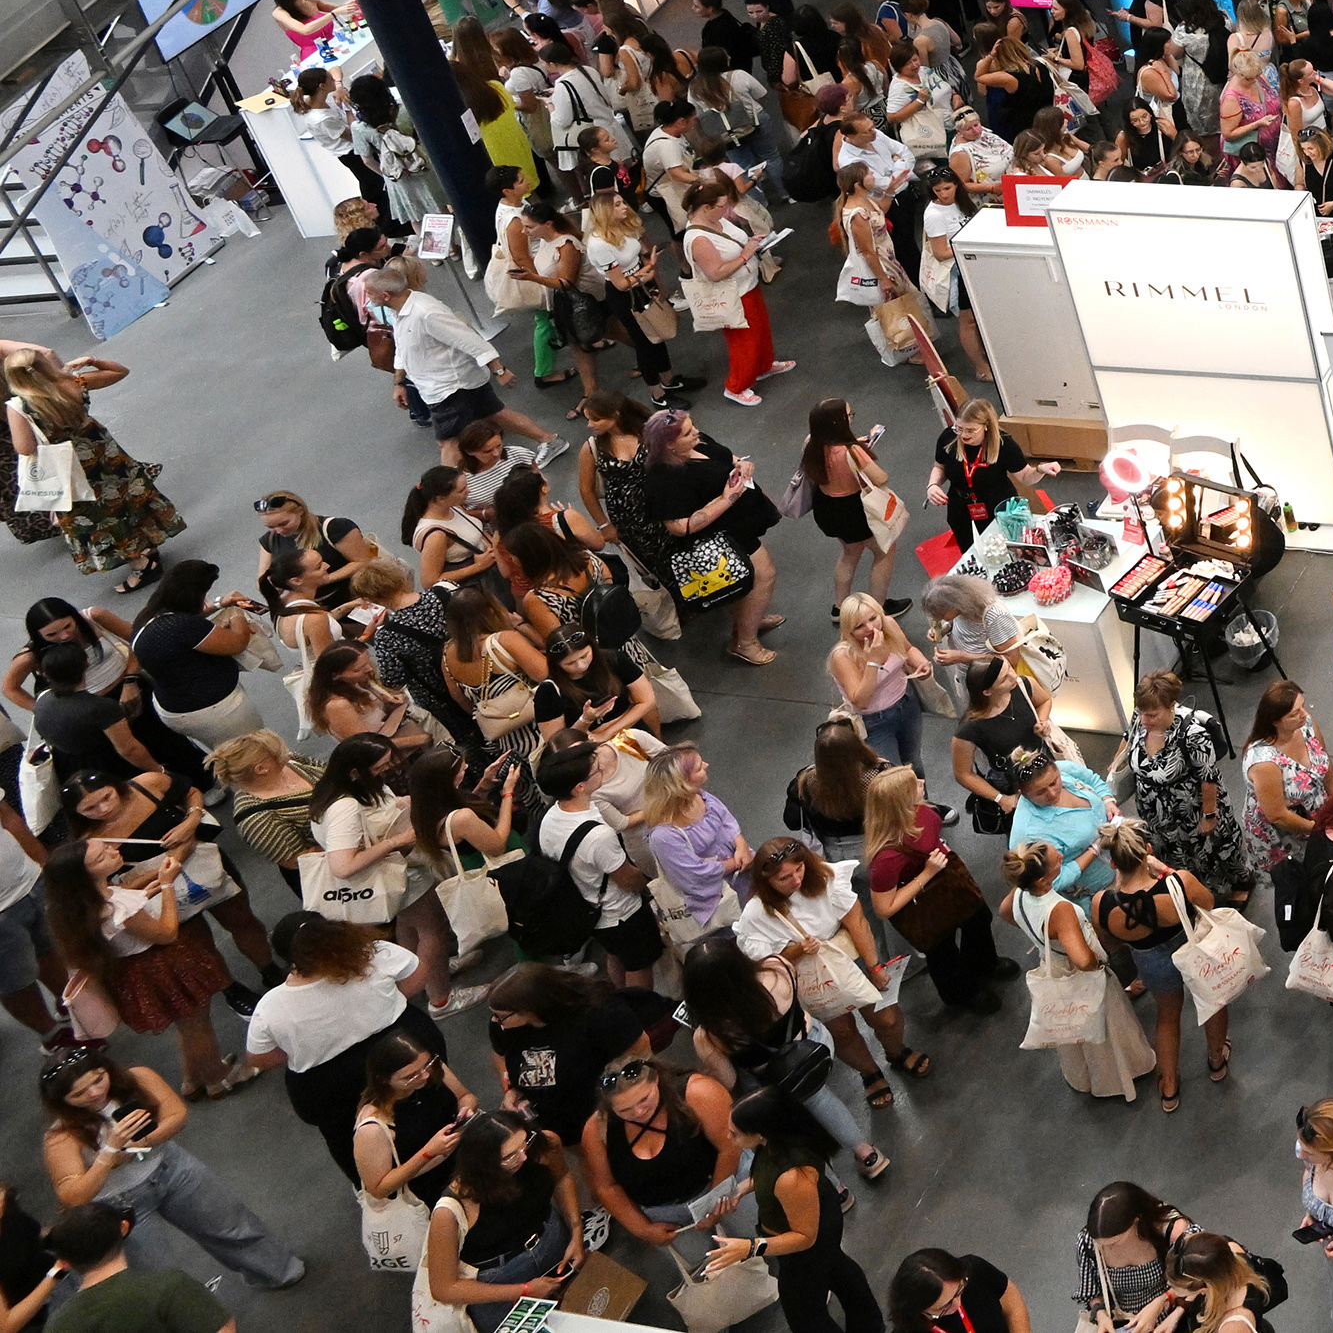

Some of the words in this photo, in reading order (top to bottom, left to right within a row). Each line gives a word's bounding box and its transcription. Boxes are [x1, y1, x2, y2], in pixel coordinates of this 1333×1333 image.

[1057, 217, 1118, 227] ROSSMANN
[1104, 280, 1267, 305] RIMMEL
[1218, 304, 1268, 312] LONDON
[19, 489, 65, 497] AGNESIUM
[323, 887, 374, 904] alpro
